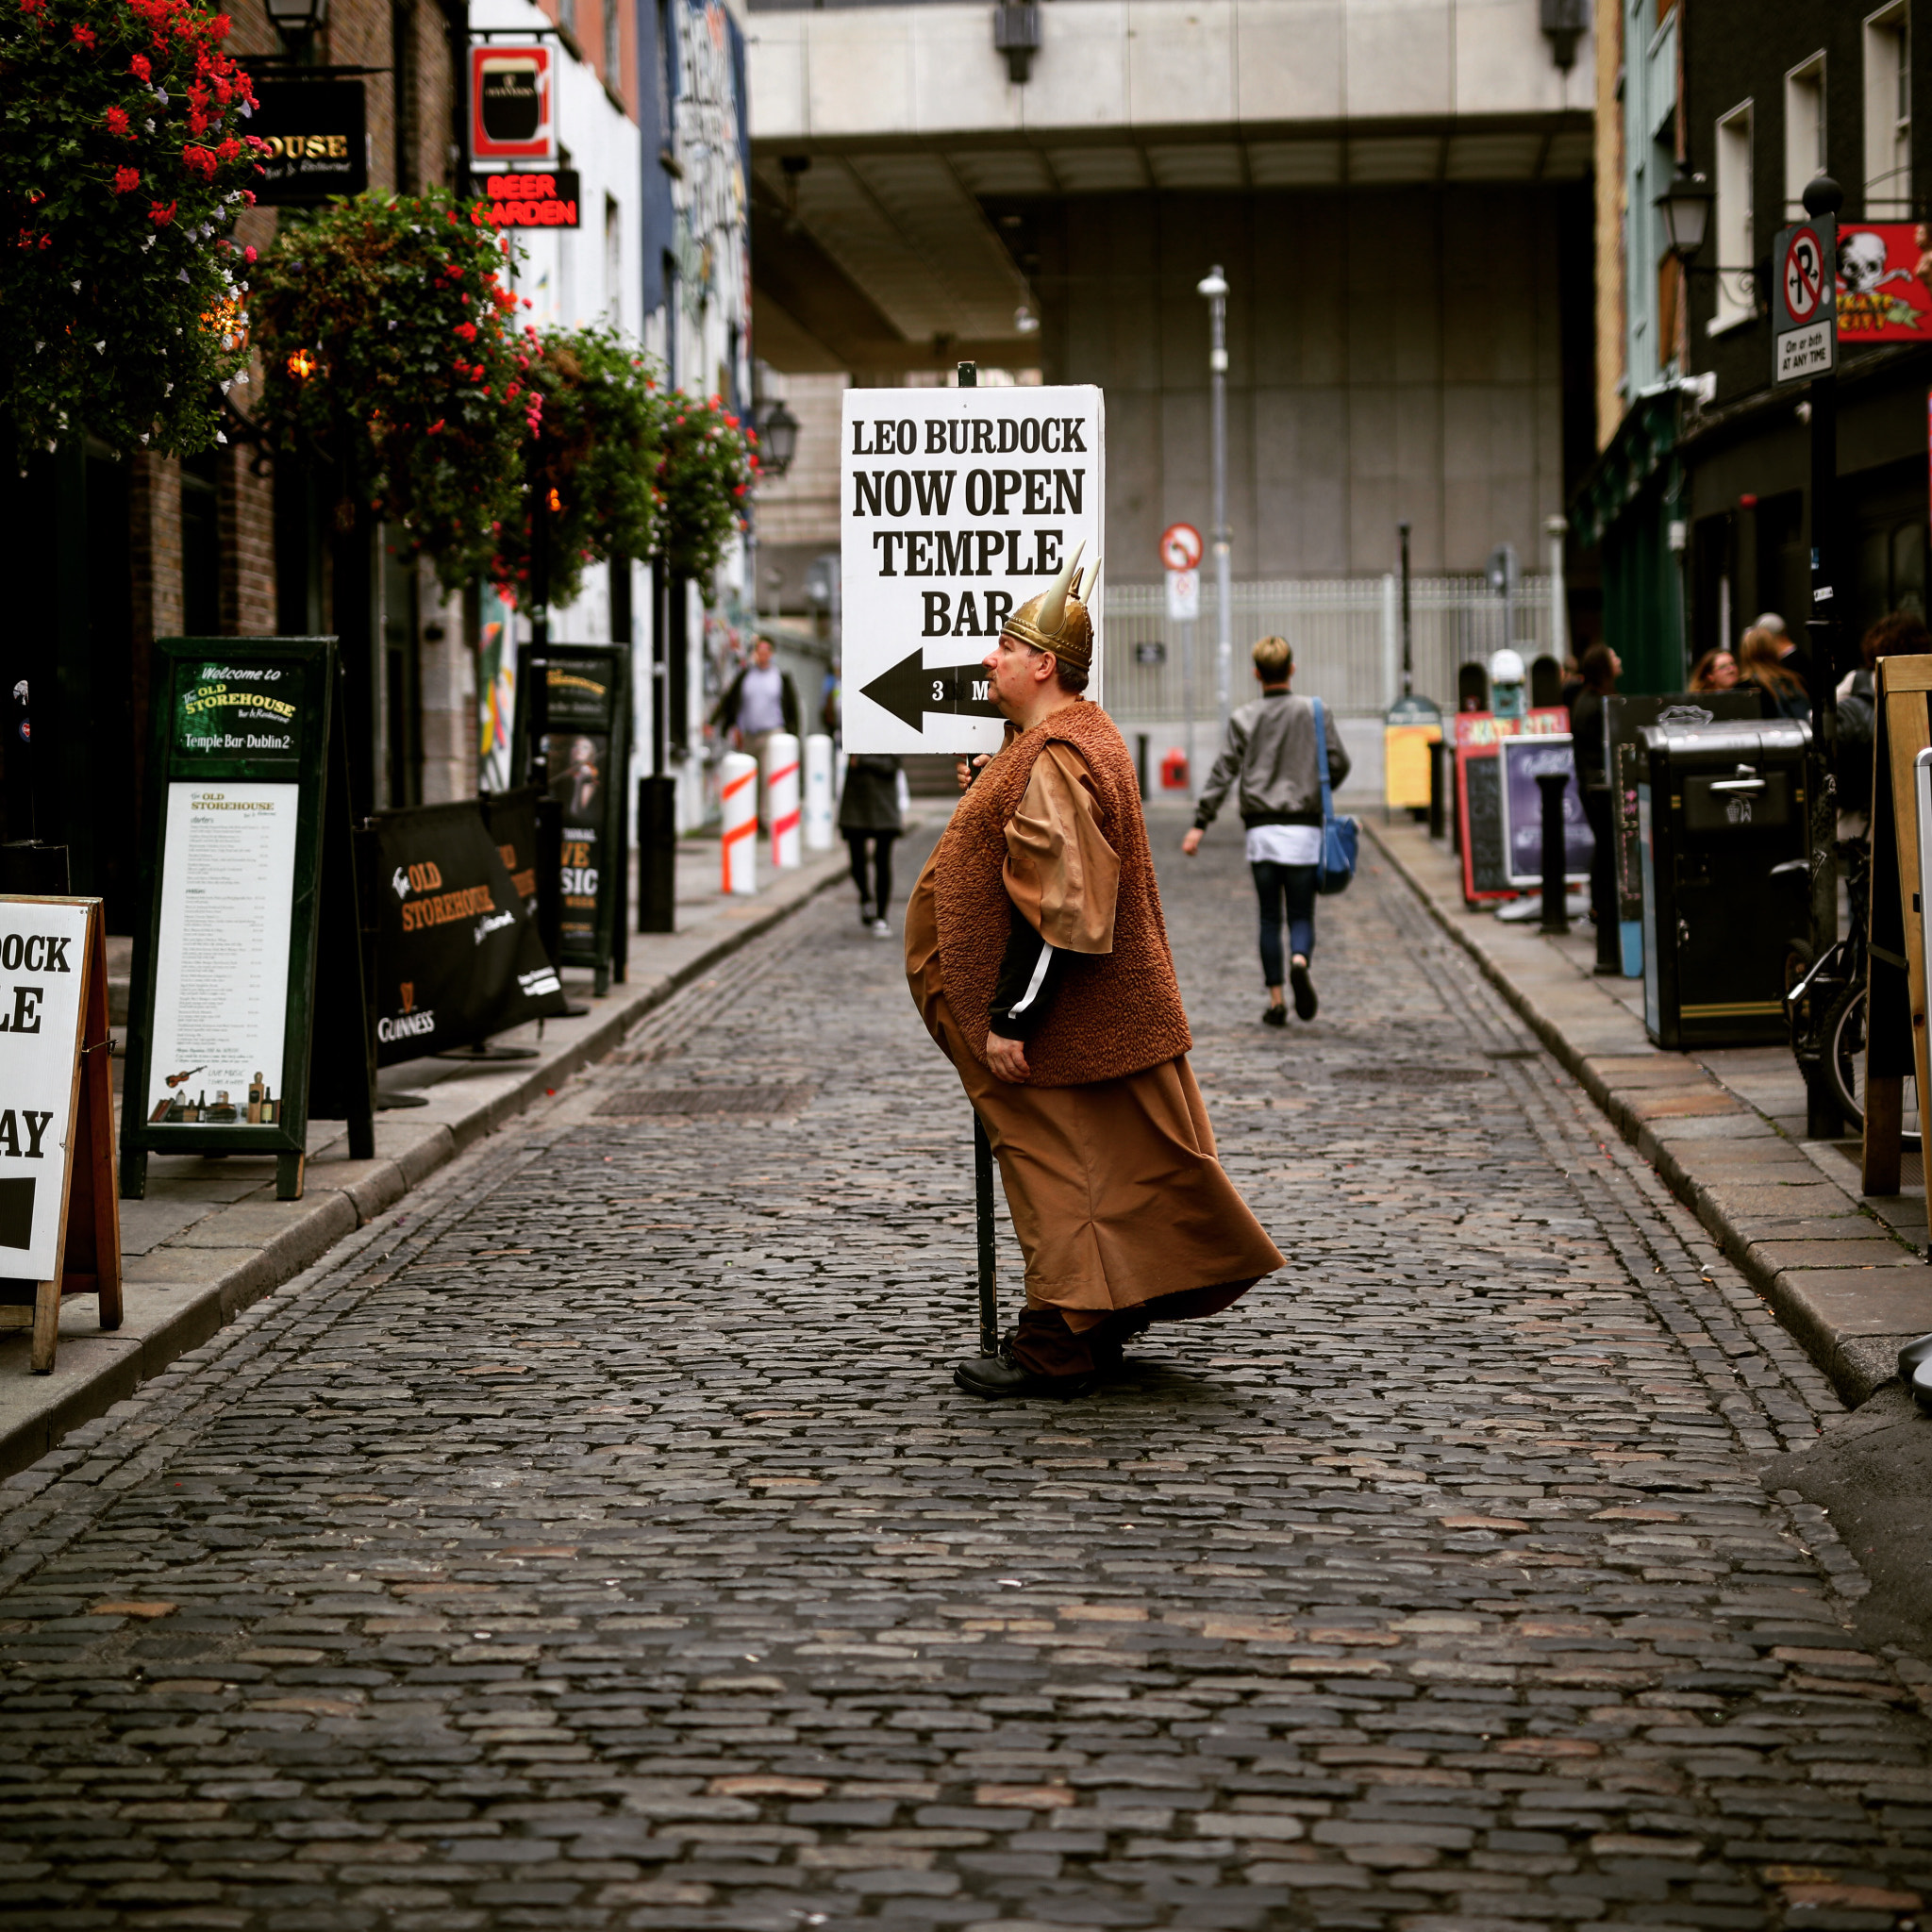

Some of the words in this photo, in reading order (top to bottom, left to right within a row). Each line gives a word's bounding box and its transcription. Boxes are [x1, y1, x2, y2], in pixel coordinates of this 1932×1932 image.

[263, 135, 347, 159] OUSE
[487, 174, 557, 200] BEER
[1793, 352, 1808, 368] ANY
[1809, 346, 1826, 362] TIME
[852, 419, 917, 455] LEO
[924, 417, 1088, 454] BURDOCK
[852, 469, 958, 517] NOW
[965, 468, 1086, 516] OPEN
[873, 529, 1064, 576] TEMPLE
[921, 591, 1013, 637] BAR
[201, 666, 263, 680] Welcome
[264, 668, 281, 680] to
[197, 683, 226, 697] OLD
[932, 680, 943, 701] 3
[185, 692, 295, 718] STOREHOUSE
[185, 733, 223, 753] Temple
[225, 733, 244, 748] Bar
[246, 734, 281, 749] Dublin
[191, 802, 275, 810] STOREHOUSE
[202, 792, 225, 801] OLD
[408, 861, 442, 892] OLD
[560, 866, 599, 895] SIC
[0, 933, 72, 973] OCK
[378, 1009, 435, 1042] GUINNESS
[0, 1108, 54, 1158] AY
